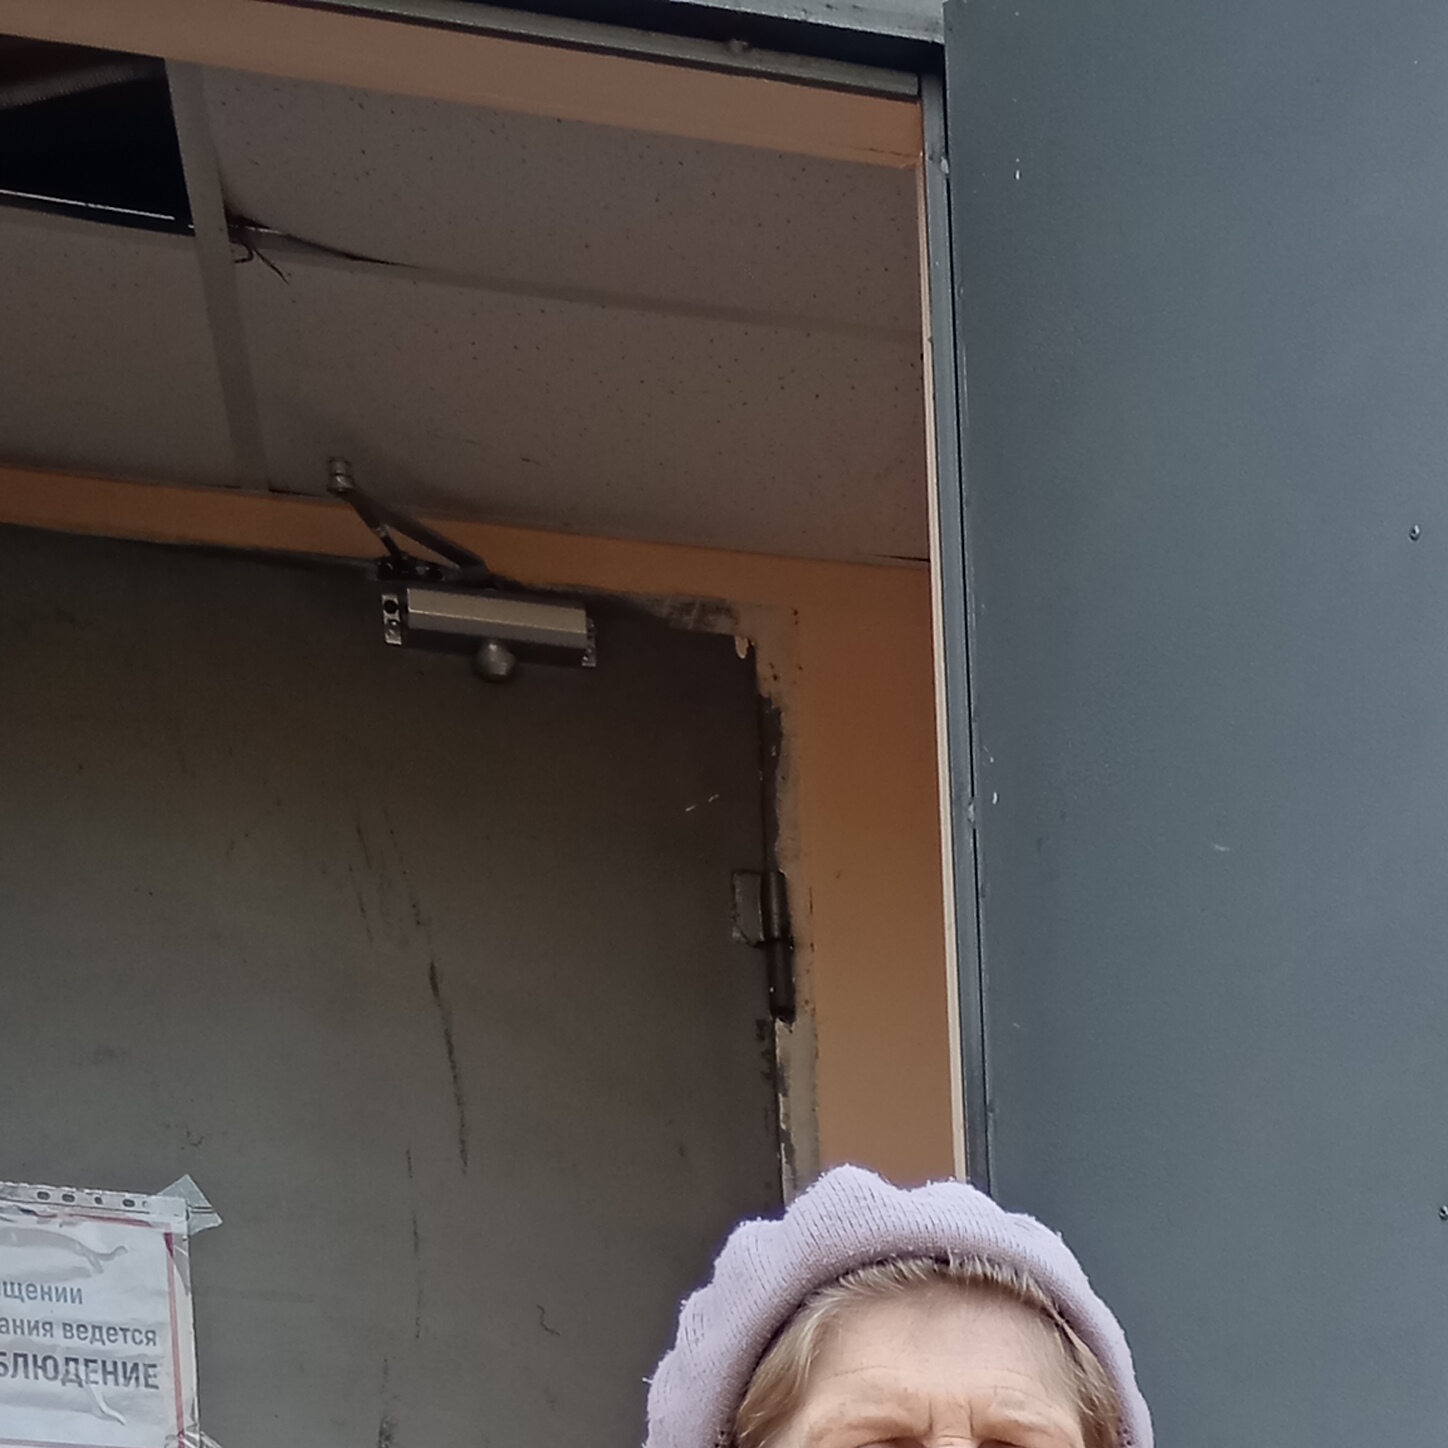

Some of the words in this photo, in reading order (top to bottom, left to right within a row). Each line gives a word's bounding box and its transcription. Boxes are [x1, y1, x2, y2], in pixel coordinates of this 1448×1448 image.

[0, 1280, 83, 1305] щении
[0, 1316, 54, 1338] ания
[62, 1322, 157, 1346] ведется
